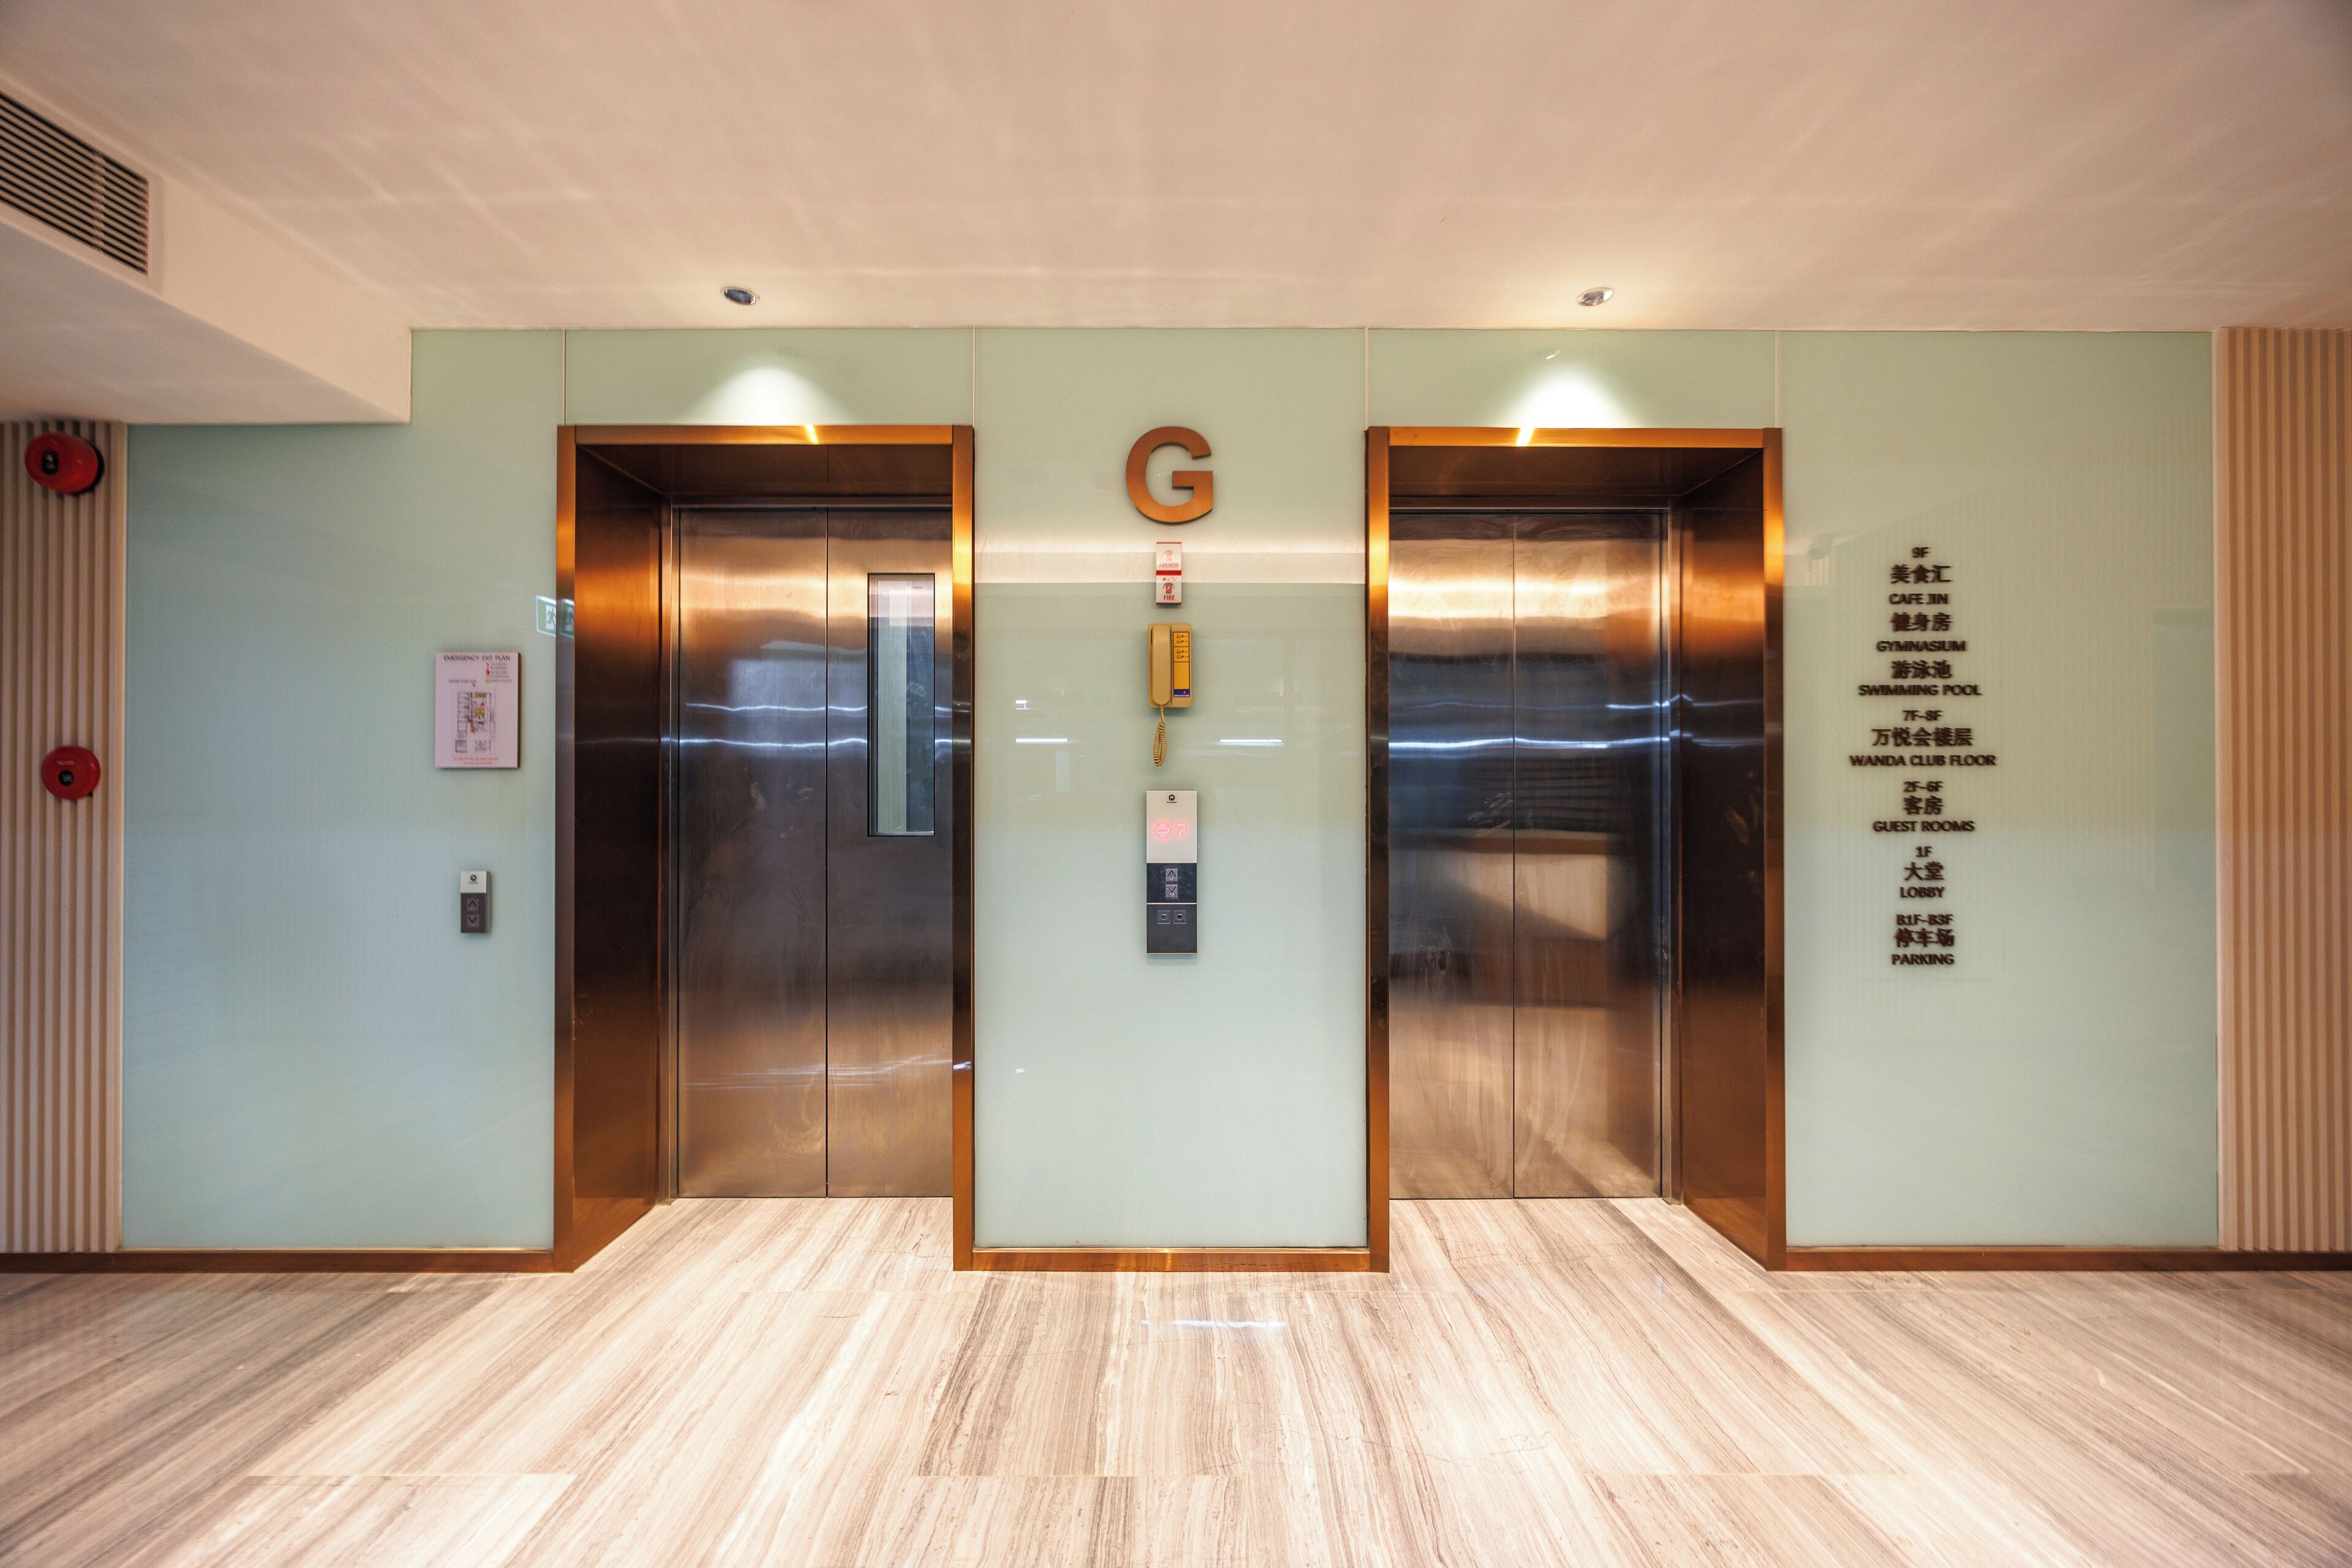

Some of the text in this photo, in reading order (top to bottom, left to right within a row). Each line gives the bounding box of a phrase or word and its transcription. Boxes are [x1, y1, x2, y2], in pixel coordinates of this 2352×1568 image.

[1126, 426, 1213, 524] G
[1912, 548, 1929, 557] 9F
[1891, 565, 1951, 582] 美食汇
[1890, 594, 1948, 604] CAFE JIN
[1891, 612, 1951, 631] 健身房
[1877, 641, 1966, 652] GYMNASIUM
[1892, 660, 1951, 678] 游泳池
[1858, 685, 1981, 695] SWIMMING POOL
[1872, 728, 1973, 745] 万悦会楼层
[1850, 755, 1996, 765] WANDA CLUB FLOOR
[1904, 796, 1943, 814] 客房
[1177, 824, 1186, 837] 7
[1873, 821, 1974, 832] GUEST ROOMS
[1917, 846, 1931, 857] 1F
[1905, 862, 1943, 881] 大堂
[1901, 887, 1944, 897] LOBBY
[1895, 928, 1954, 947] 停车场
[1892, 954, 1953, 965] PARKING
